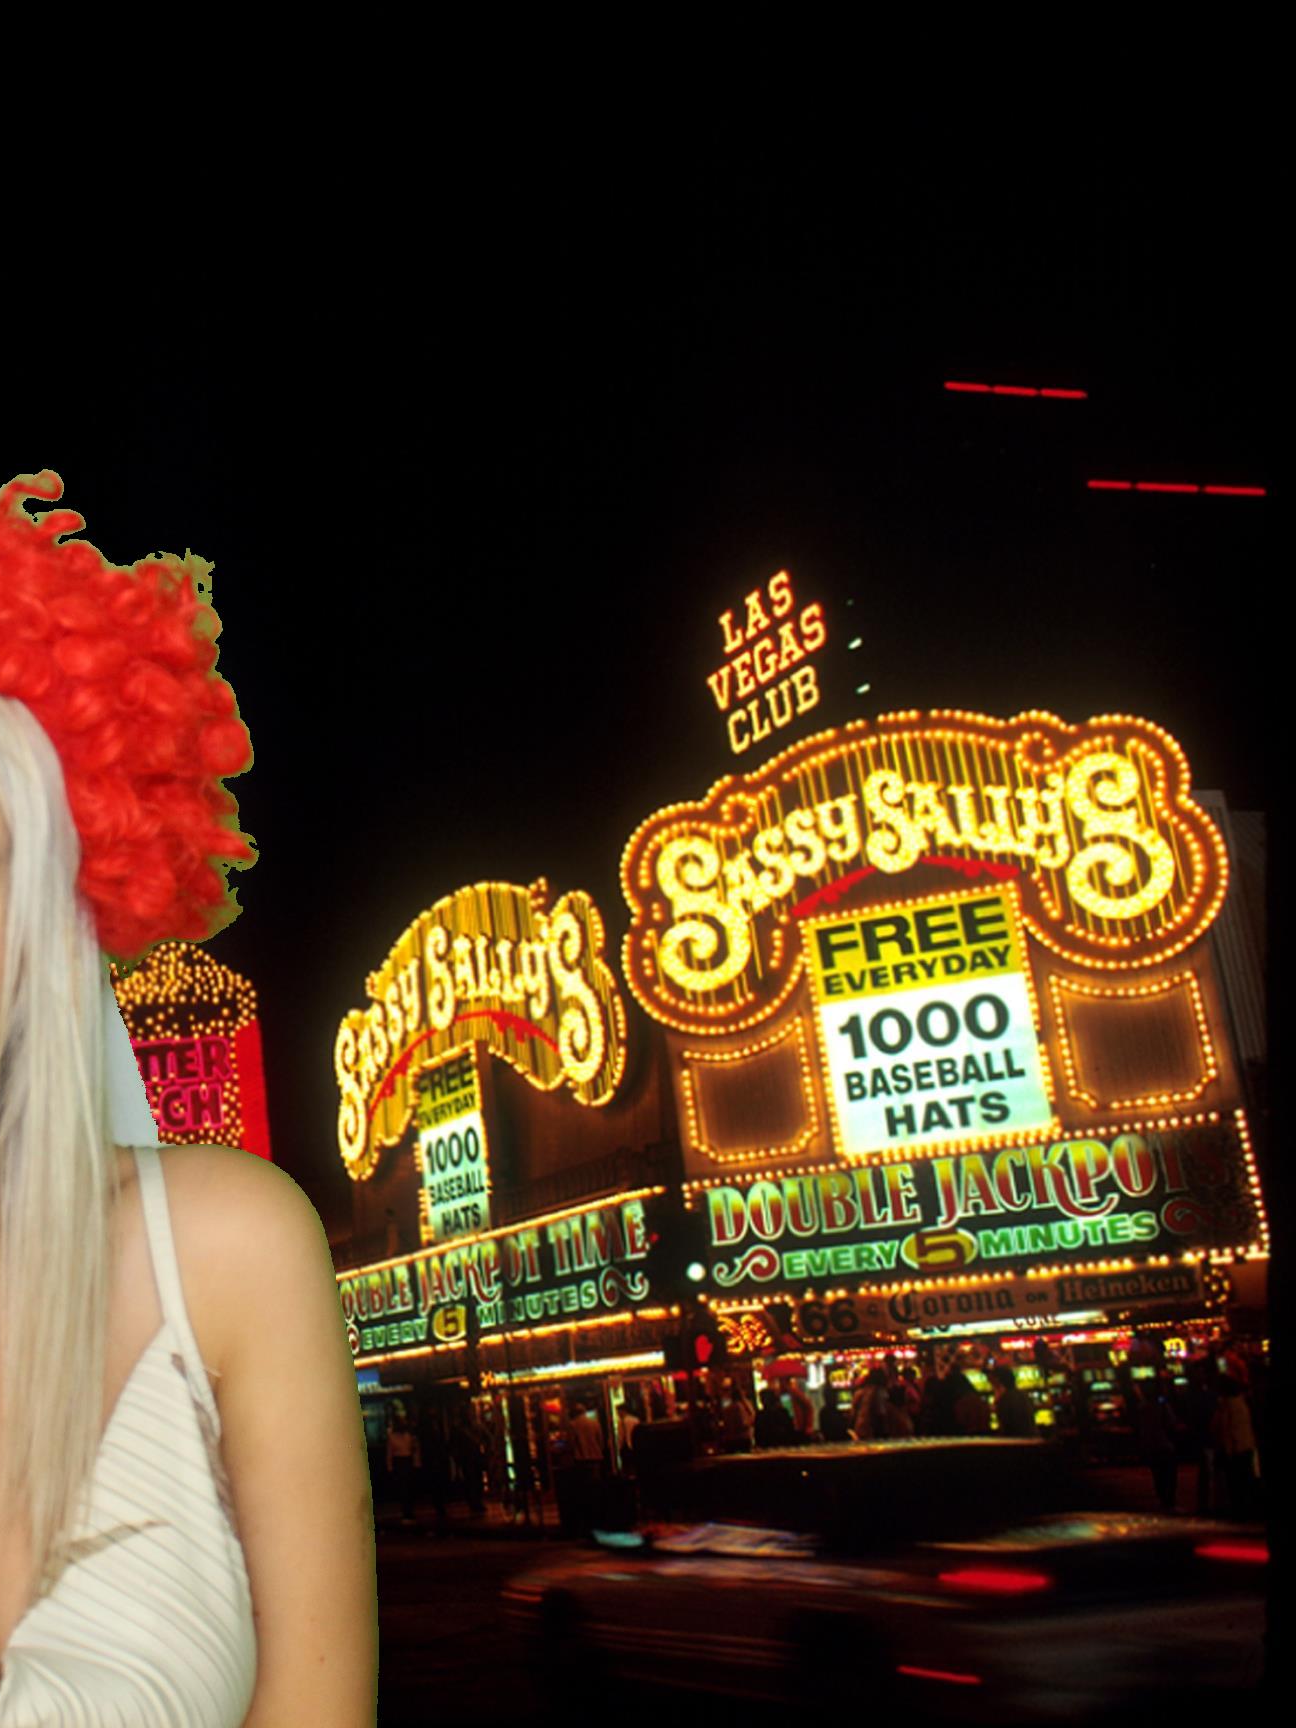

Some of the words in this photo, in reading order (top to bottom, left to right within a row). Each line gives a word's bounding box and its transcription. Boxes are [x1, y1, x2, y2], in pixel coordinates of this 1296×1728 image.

[718, 569, 794, 654] LAS
[707, 602, 826, 711] VEGAS
[727, 664, 820, 755] CLUB
[657, 793, 861, 991] SASSY
[815, 895, 1011, 971] FREE
[822, 945, 1011, 996] EVERYDAY
[838, 993, 1010, 1060] 1000
[335, 957, 422, 1160] SASSY
[417, 1052, 475, 1101] FREE
[844, 1048, 1025, 1102] BASEBALL
[419, 1091, 476, 1129] EVERYDAY
[884, 1091, 1011, 1138] HATS
[426, 1126, 480, 1175] 1000
[430, 1169, 485, 1206] BASEBALL
[708, 1163, 921, 1245] DOUBLE
[442, 1203, 482, 1236] HATS
[782, 1240, 900, 1280] EVERY
[914, 1229, 968, 1270] 5
[978, 1210, 1160, 1260] MINUTES
[339, 1264, 413, 1323] OUBLE
[547, 1198, 650, 1277] TIME
[887, 1286, 1016, 1326] Corona
[1062, 1272, 1189, 1305] Heineken
[362, 1317, 429, 1350] EVERY
